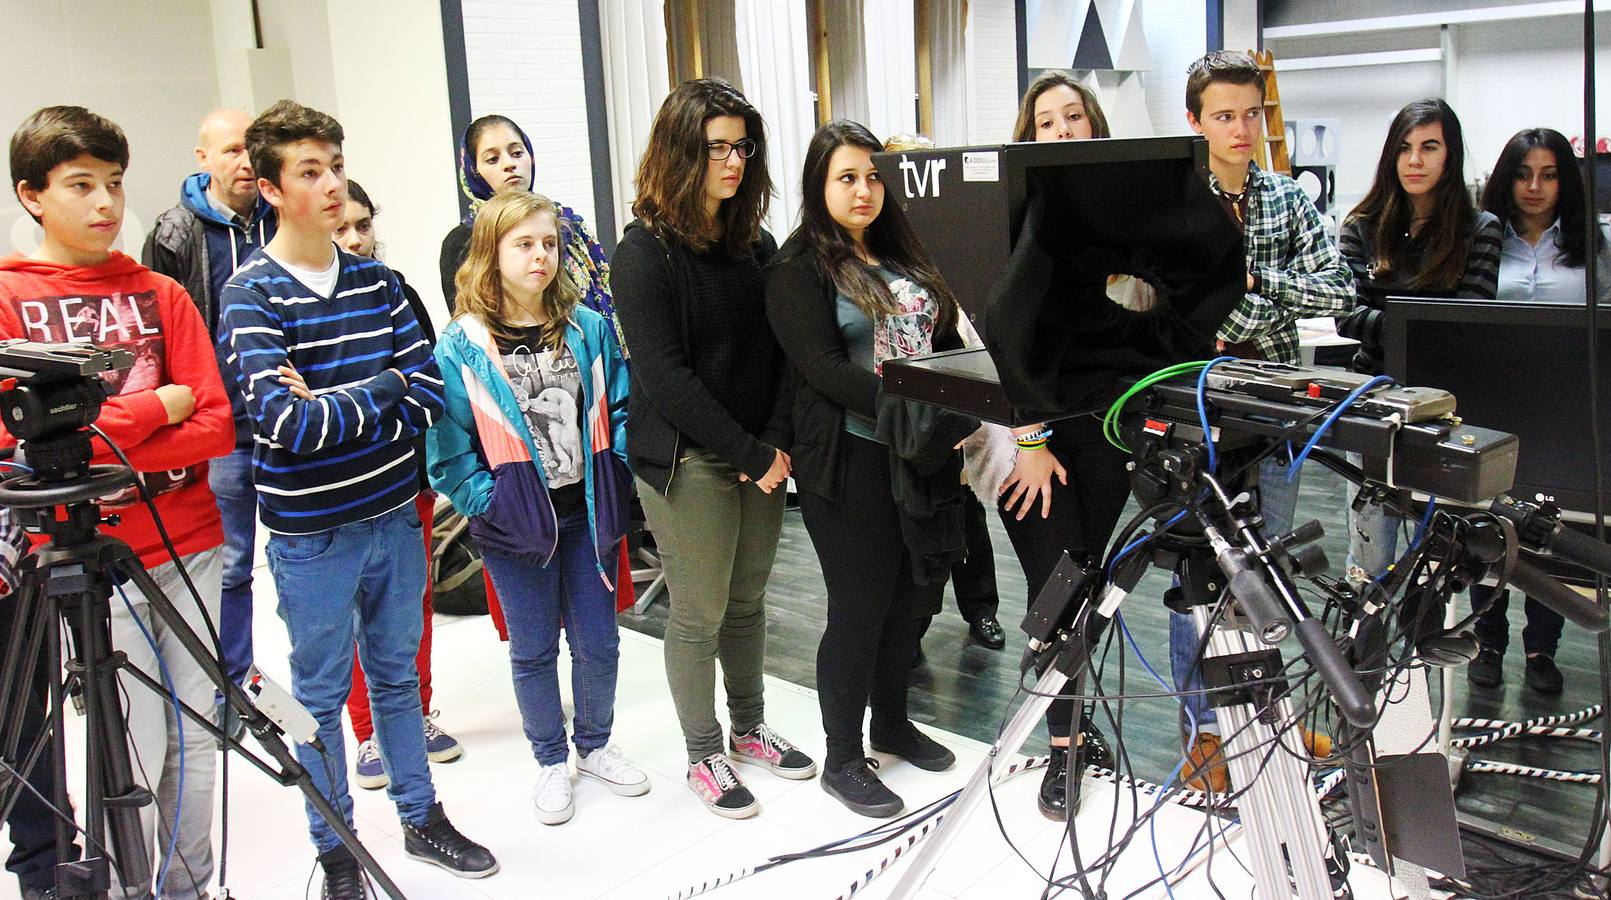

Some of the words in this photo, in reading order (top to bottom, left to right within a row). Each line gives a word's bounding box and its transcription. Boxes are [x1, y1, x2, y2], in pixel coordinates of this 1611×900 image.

[899, 155, 946, 198] tvr
[22, 296, 158, 342] REAL
[557, 372, 569, 381] THE
